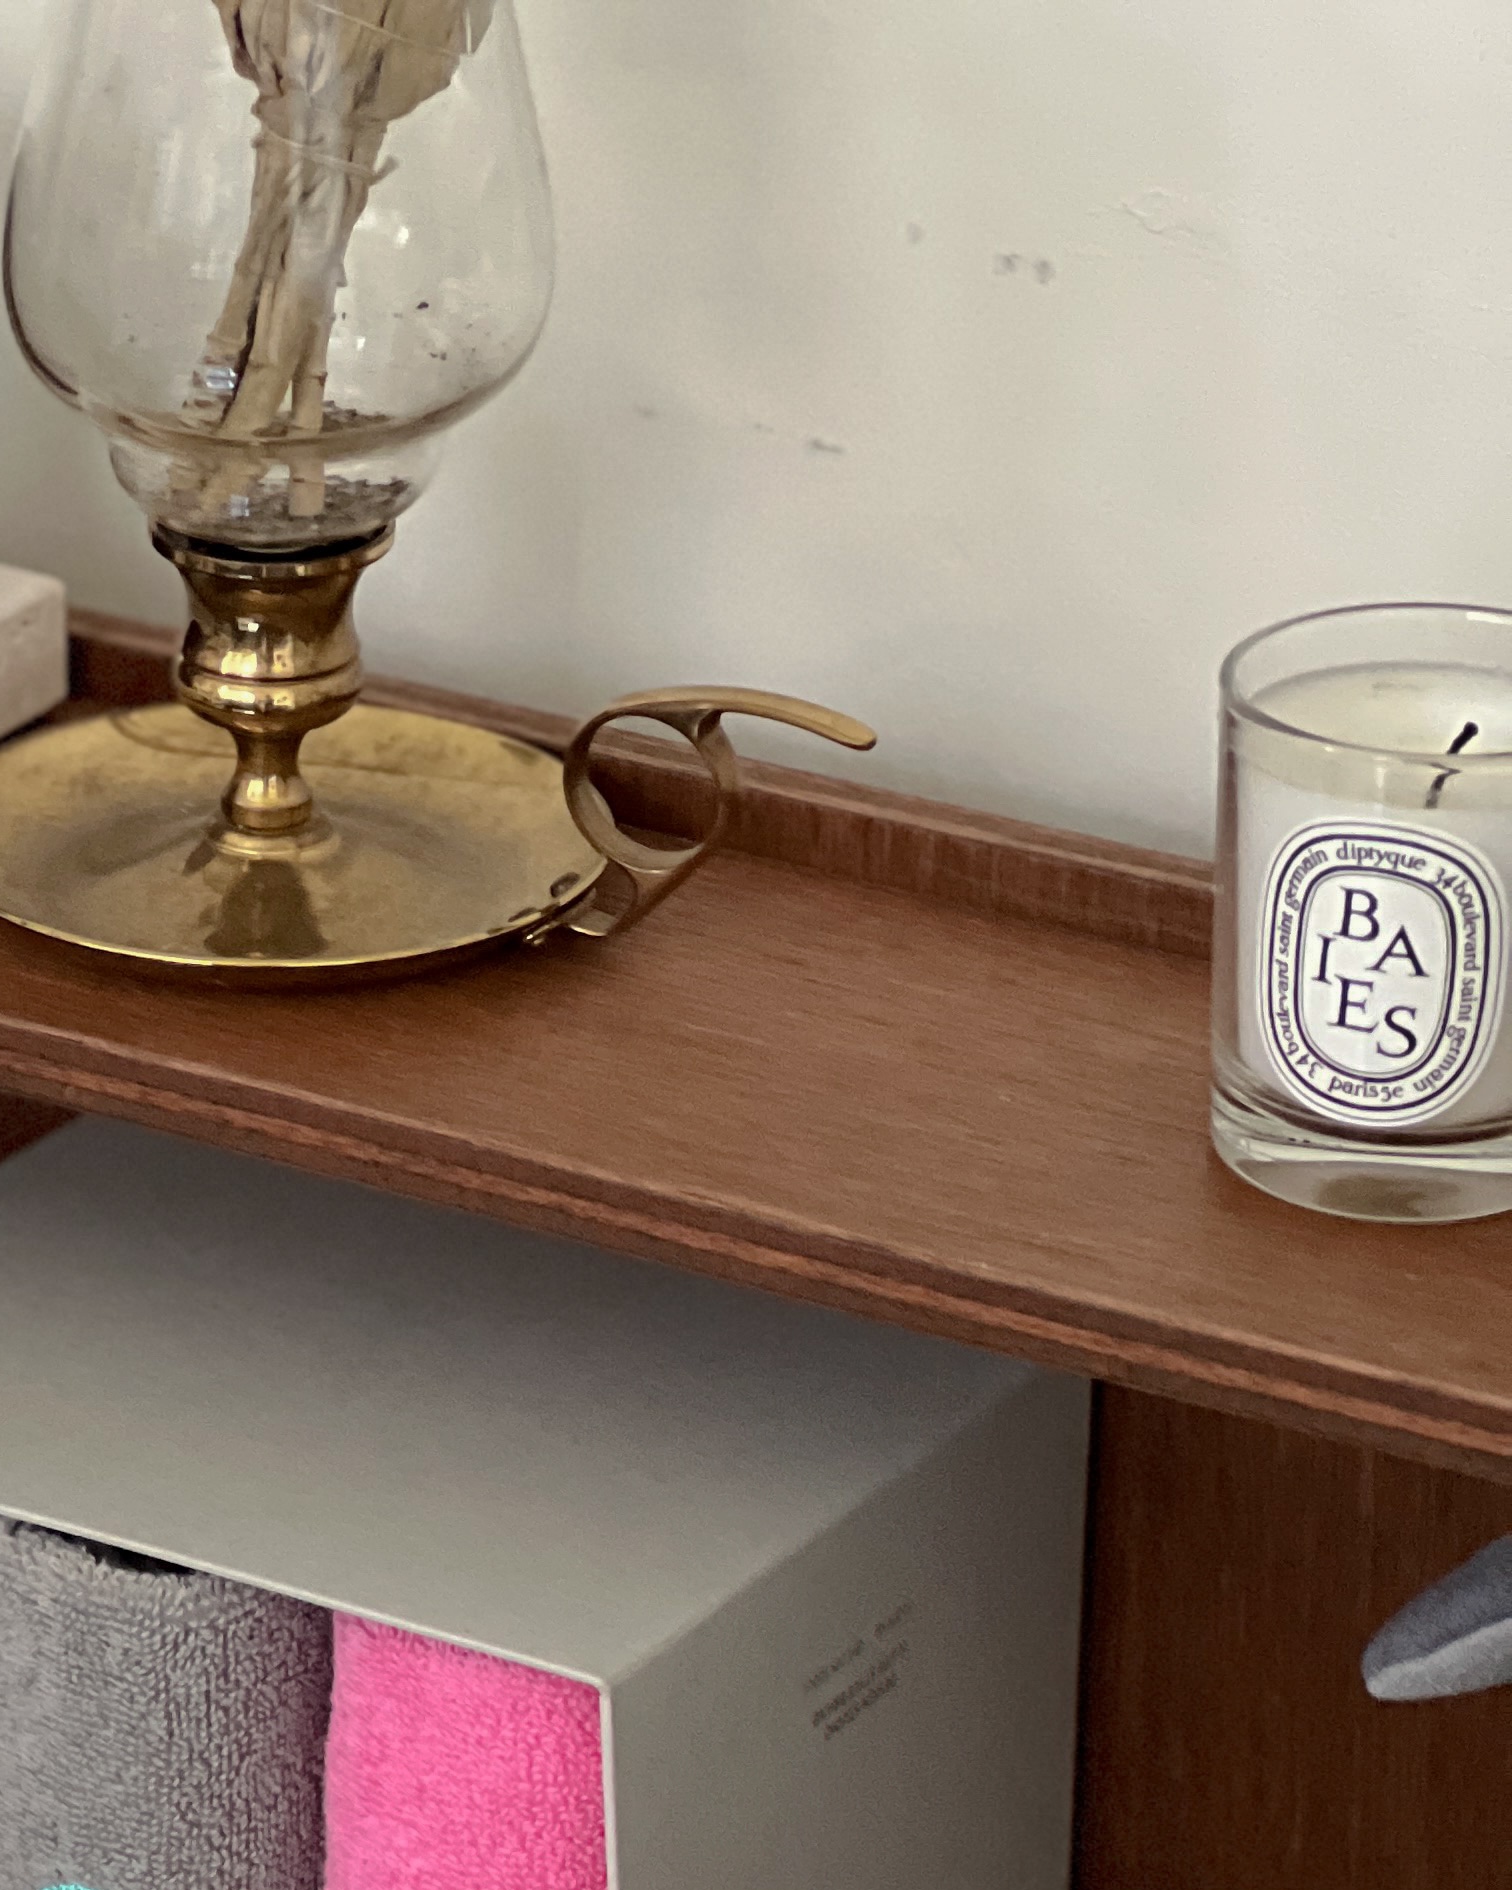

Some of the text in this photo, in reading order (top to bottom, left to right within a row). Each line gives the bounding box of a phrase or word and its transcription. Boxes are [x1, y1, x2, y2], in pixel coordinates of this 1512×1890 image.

[1275, 847, 1329, 1079] 34 boulevard saint germain
[1335, 840, 1426, 871] diptyque
[1412, 867, 1481, 1092] 34 boulevard saint germain
